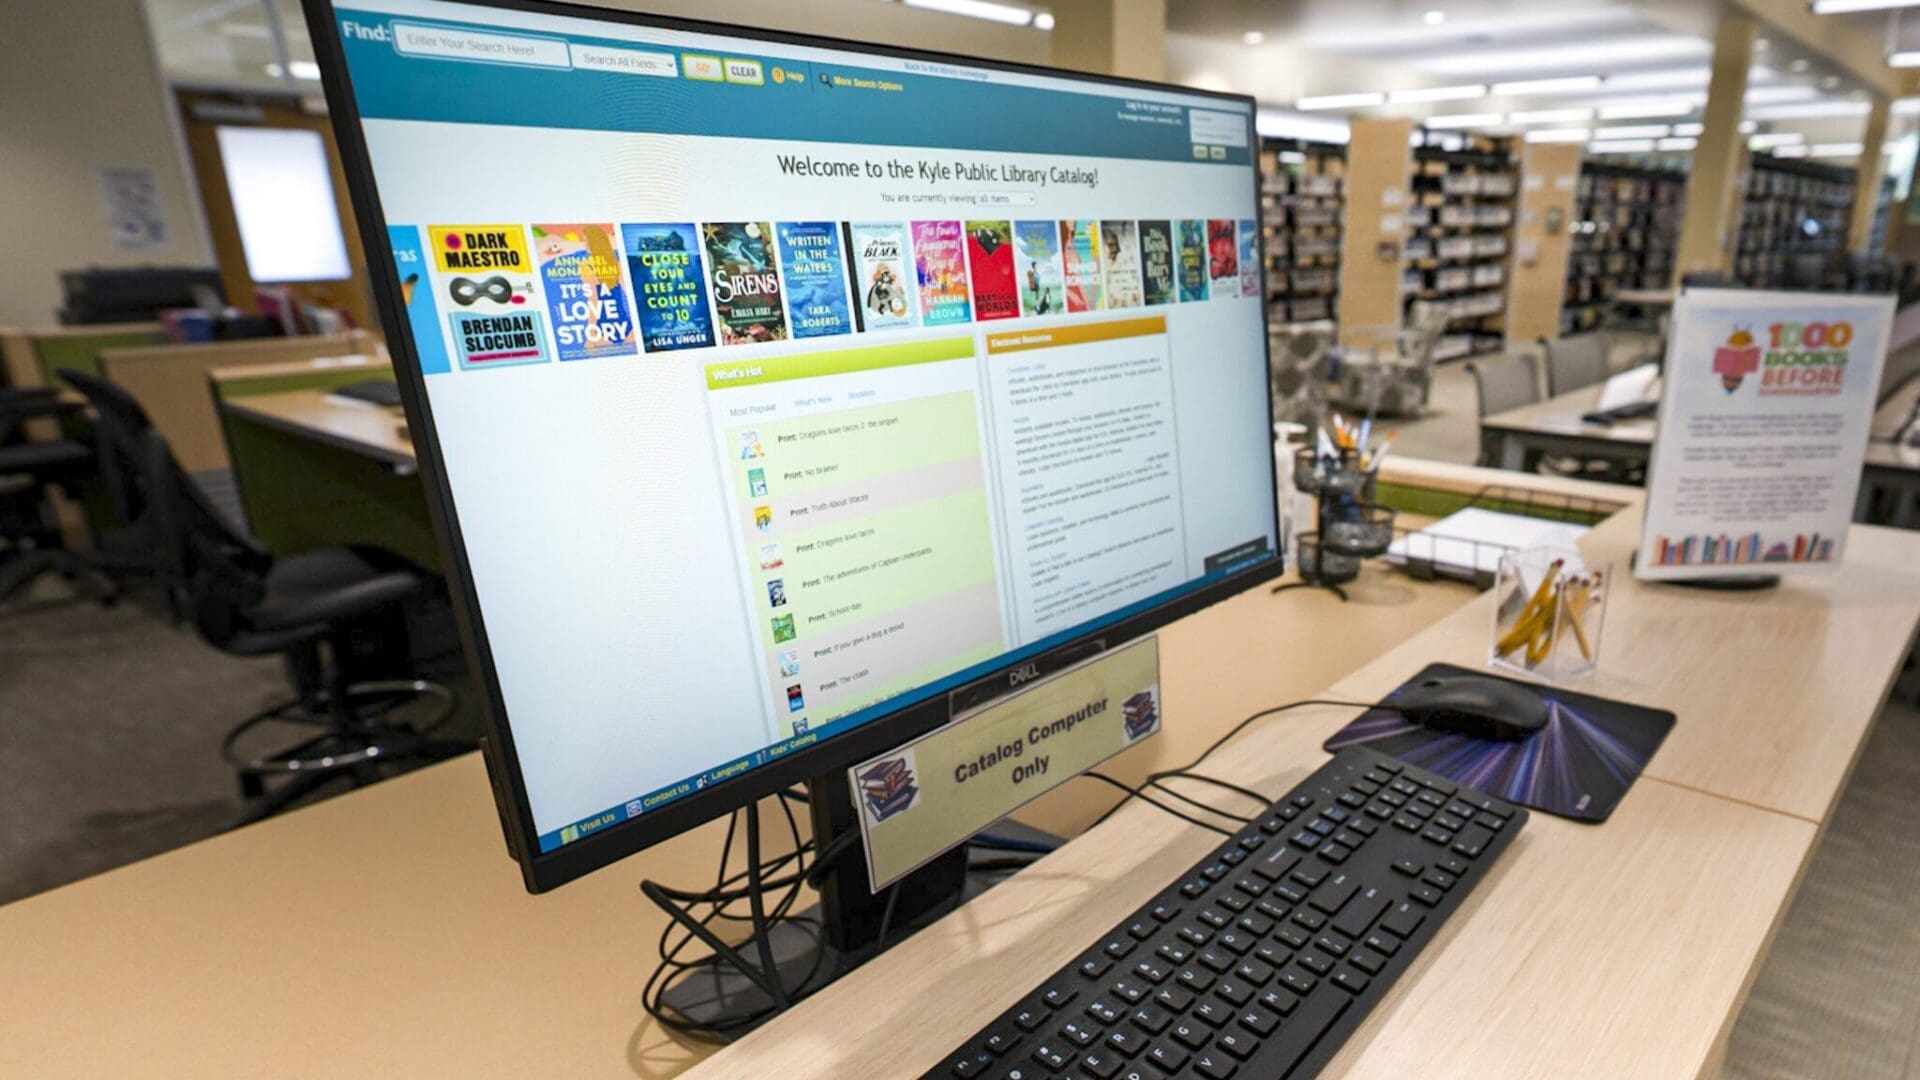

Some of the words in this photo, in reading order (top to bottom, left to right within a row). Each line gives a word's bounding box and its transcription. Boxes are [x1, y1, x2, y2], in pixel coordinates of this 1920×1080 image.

[342, 20, 391, 41] Find:
[407, 33, 437, 47] Enter
[440, 37, 465, 49] Your
[467, 40, 505, 53] Search
[507, 44, 535, 56] Here!
[583, 53, 616, 67] Search
[617, 57, 629, 68] All
[631, 58, 657, 70] Fields
[731, 66, 757, 78] CLEAR
[786, 72, 804, 83] Help
[833, 76, 852, 86] More
[853, 78, 877, 89] Search
[878, 80, 903, 92] Options
[777, 154, 860, 177] Welcome
[865, 159, 883, 178] to
[887, 159, 914, 179] the
[919, 161, 951, 184] Kyle
[955, 162, 998, 182] Public
[1001, 164, 1047, 186] Library
[1050, 166, 1099, 189] Catalog!
[880, 192, 896, 203] You
[897, 194, 910, 203] are
[912, 193, 947, 205] currently
[949, 194, 976, 206] viewing
[980, 194, 989, 203] all
[991, 195, 1010, 204] items
[465, 232, 508, 249] DARK
[786, 235, 832, 247] WRITTEN
[444, 251, 521, 268] MAESTRO
[641, 251, 690, 268] CLOSE
[794, 250, 807, 260] IN
[810, 249, 828, 259] THE
[651, 268, 684, 280] YOUR
[793, 262, 833, 274] WATERS
[559, 283, 593, 299] IT'S
[600, 282, 612, 297] A
[644, 282, 674, 294] EYES
[677, 282, 696, 290] AND
[715, 268, 778, 303] SIRENS
[647, 294, 698, 308] COUNT
[559, 299, 619, 322] LOVE
[661, 313, 673, 321] TO
[676, 309, 690, 322] 10
[807, 306, 831, 315] TARA
[930, 308, 964, 320] BROWN
[461, 316, 533, 335] BRENDAN
[802, 317, 840, 328] ROBERTS
[557, 321, 628, 345] STORY
[652, 336, 673, 347] LISA
[676, 334, 707, 345] UNGER
[1768, 321, 1854, 349] 1000
[466, 332, 537, 352] SLOCUMB
[1763, 351, 1848, 367] BOOKS
[713, 368, 745, 381] What's
[746, 367, 762, 377] Hot
[1762, 367, 1846, 386] BEFORE
[730, 406, 747, 418] Most
[750, 403, 777, 415] Popular
[778, 433, 797, 443] Print:
[799, 428, 827, 441] Dragons
[843, 422, 859, 433] tacos
[784, 471, 803, 481] Print:
[805, 468, 815, 477] No
[816, 464, 838, 475] brainer
[790, 506, 809, 517] Print:
[811, 501, 828, 512] Truth
[829, 498, 847, 508] About
[796, 542, 815, 553] Print:
[816, 537, 844, 550] Dragons
[859, 528, 875, 538] tacos
[802, 579, 821, 589] Print:
[823, 573, 835, 583] The
[836, 565, 870, 579] adventures
[871, 561, 878, 570] of
[878, 556, 900, 570] Captain
[808, 613, 827, 624] Print:
[829, 606, 850, 619] School
[851, 602, 862, 613] day
[814, 647, 832, 658] Print:
[820, 681, 837, 692] Print:
[839, 676, 851, 686] The
[852, 669, 869, 680] crash
[1008, 662, 1040, 687] DELL
[770, 743, 789, 757] Kids'
[790, 732, 817, 749] Catalog
[954, 736, 1024, 784] Catalog
[1028, 696, 1110, 746] Computer
[711, 760, 750, 780] Language
[1011, 755, 1051, 785] Only
[643, 788, 677, 807] Contact
[678, 783, 690, 795] Us
[580, 817, 601, 833] Visit
[602, 812, 615, 825] Us
